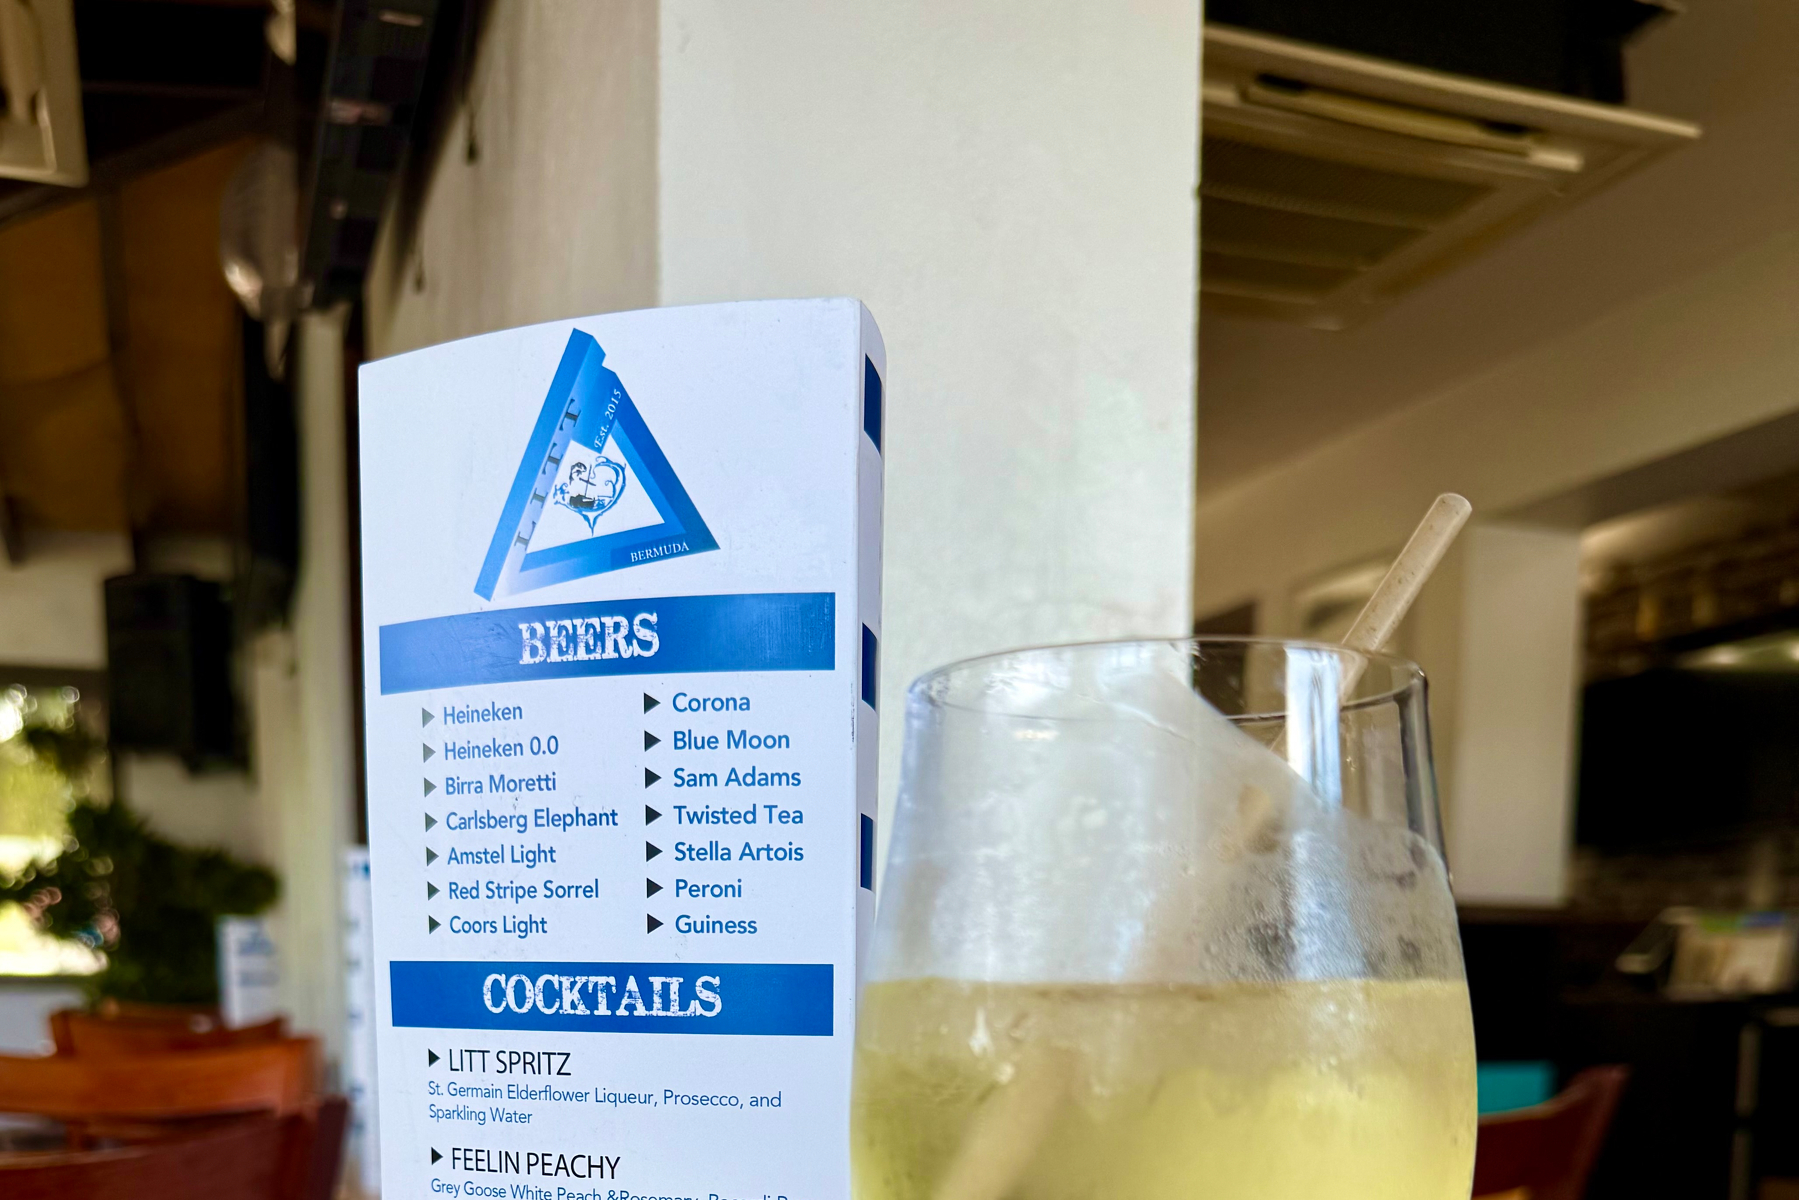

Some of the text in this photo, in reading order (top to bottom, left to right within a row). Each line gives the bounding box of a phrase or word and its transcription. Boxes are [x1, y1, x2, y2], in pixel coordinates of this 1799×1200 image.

[594, 389, 622, 449] Est. 2015
[630, 542, 689, 563] BERMUDA
[518, 612, 659, 666] BEERS
[443, 701, 523, 725] Heineken
[672, 692, 751, 713] Corona
[444, 736, 559, 761] Heineken 0.0
[673, 730, 790, 750] Blue Moon
[445, 772, 556, 795] Birra Moretti
[673, 767, 801, 788] Sam Adams
[446, 807, 619, 833] Carlsberg Elephant
[674, 805, 804, 825] Twisted Tea
[447, 844, 556, 868] Amstel Light
[674, 842, 804, 862] Stella Artois
[448, 879, 599, 903] Red Stripe Sorrel
[675, 879, 742, 898] Peroni
[449, 915, 548, 938] Coors Light
[675, 915, 758, 935] Guiness
[483, 973, 722, 1018] COCKTAILS
[449, 1049, 572, 1076] LITT SPRITZ
[428, 1081, 782, 1109] St. Germain Elderflower Liqueur, Prosecco, and
[429, 1104, 532, 1125] Sparkling Water
[452, 1147, 621, 1180] FEELIN PEACHY
[431, 1178, 461, 1197] Grey
[464, 1182, 506, 1199] Goose
